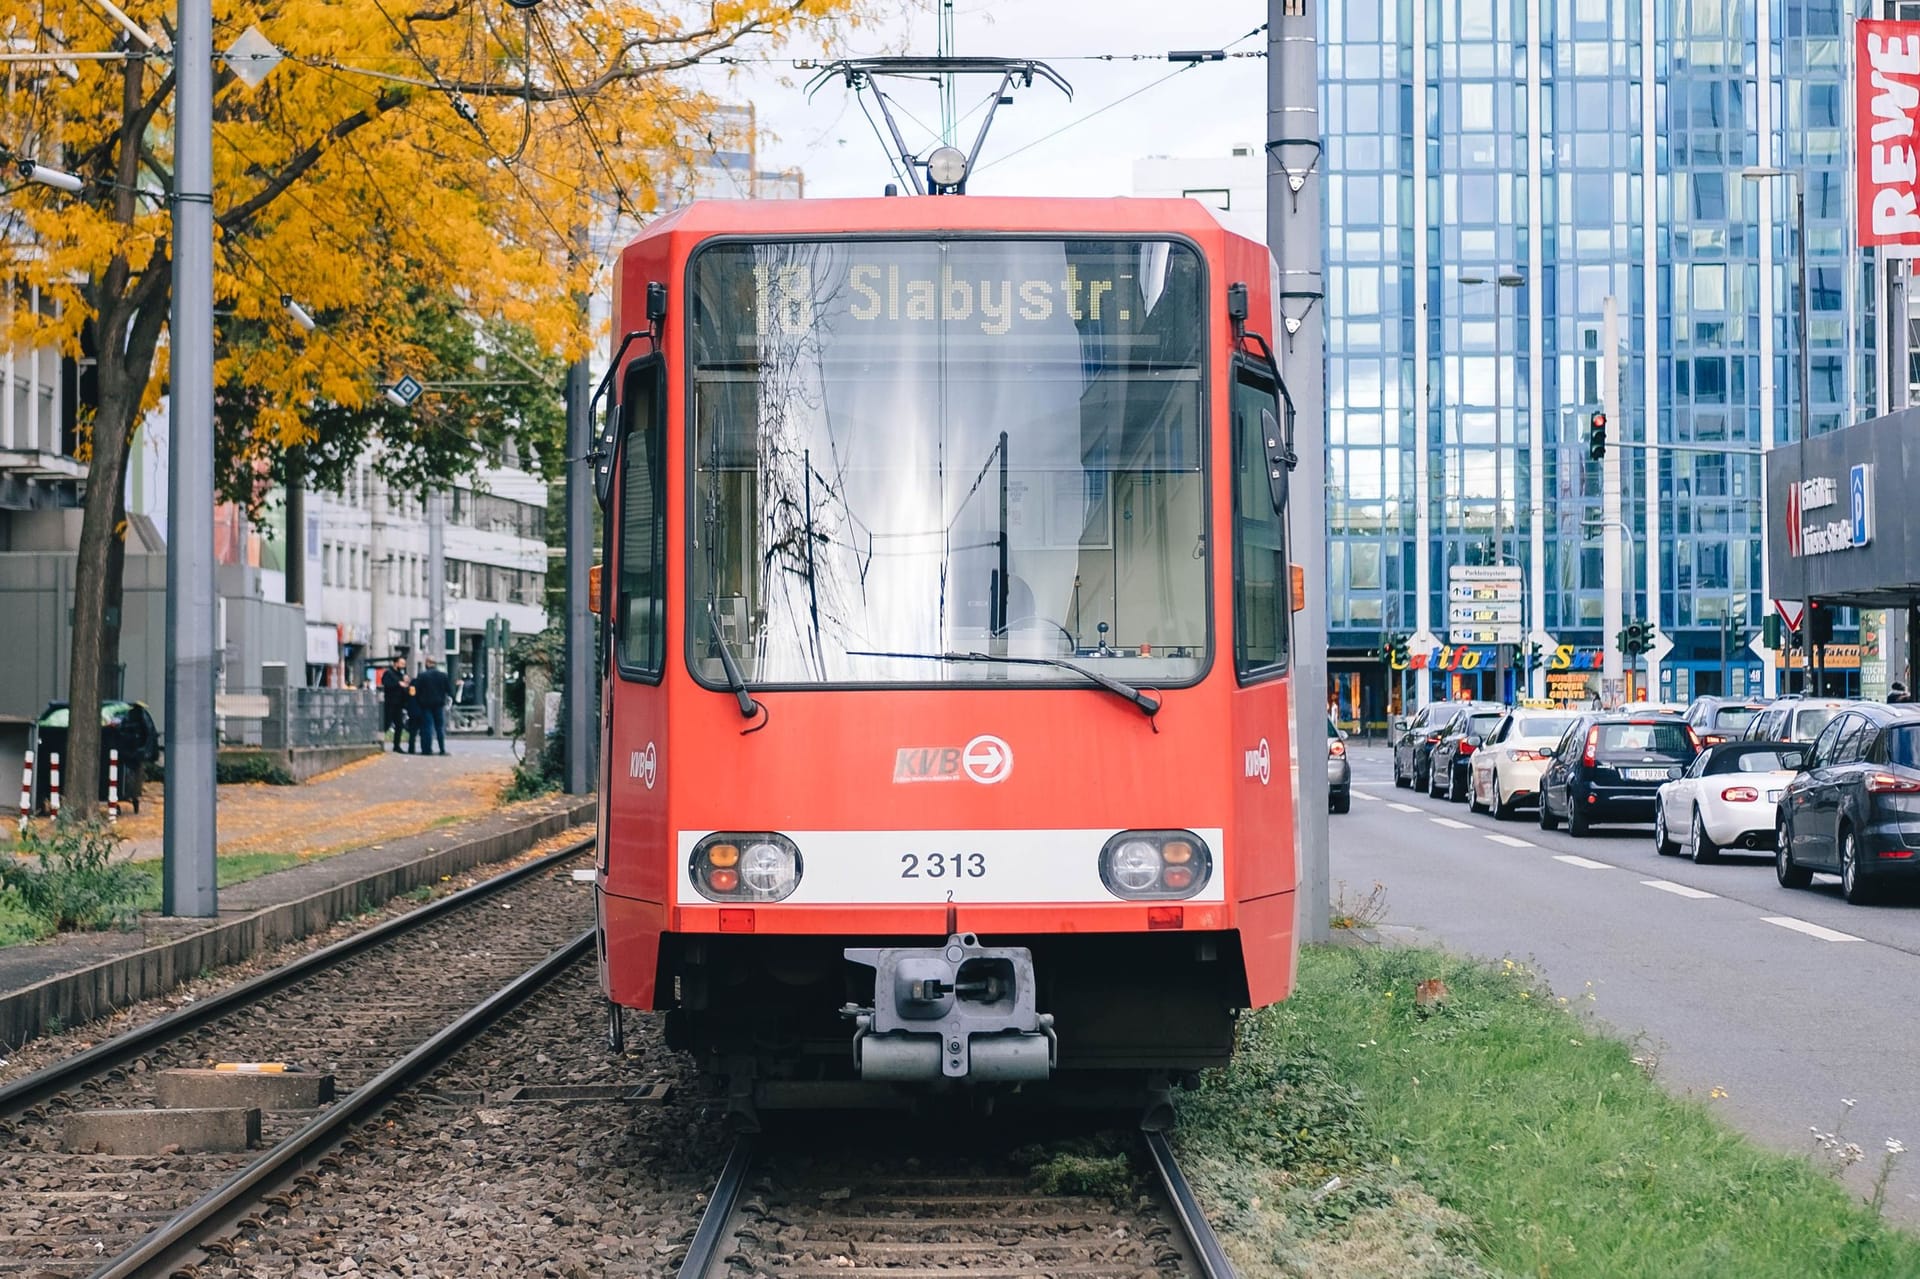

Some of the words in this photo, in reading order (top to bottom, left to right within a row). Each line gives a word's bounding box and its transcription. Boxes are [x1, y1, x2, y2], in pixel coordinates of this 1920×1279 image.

[1868, 32, 1920, 236] REWE
[753, 264, 811, 335] 18
[849, 264, 1131, 335] Slabystr.
[896, 748, 961, 775] KVB
[901, 853, 986, 878] 2313
